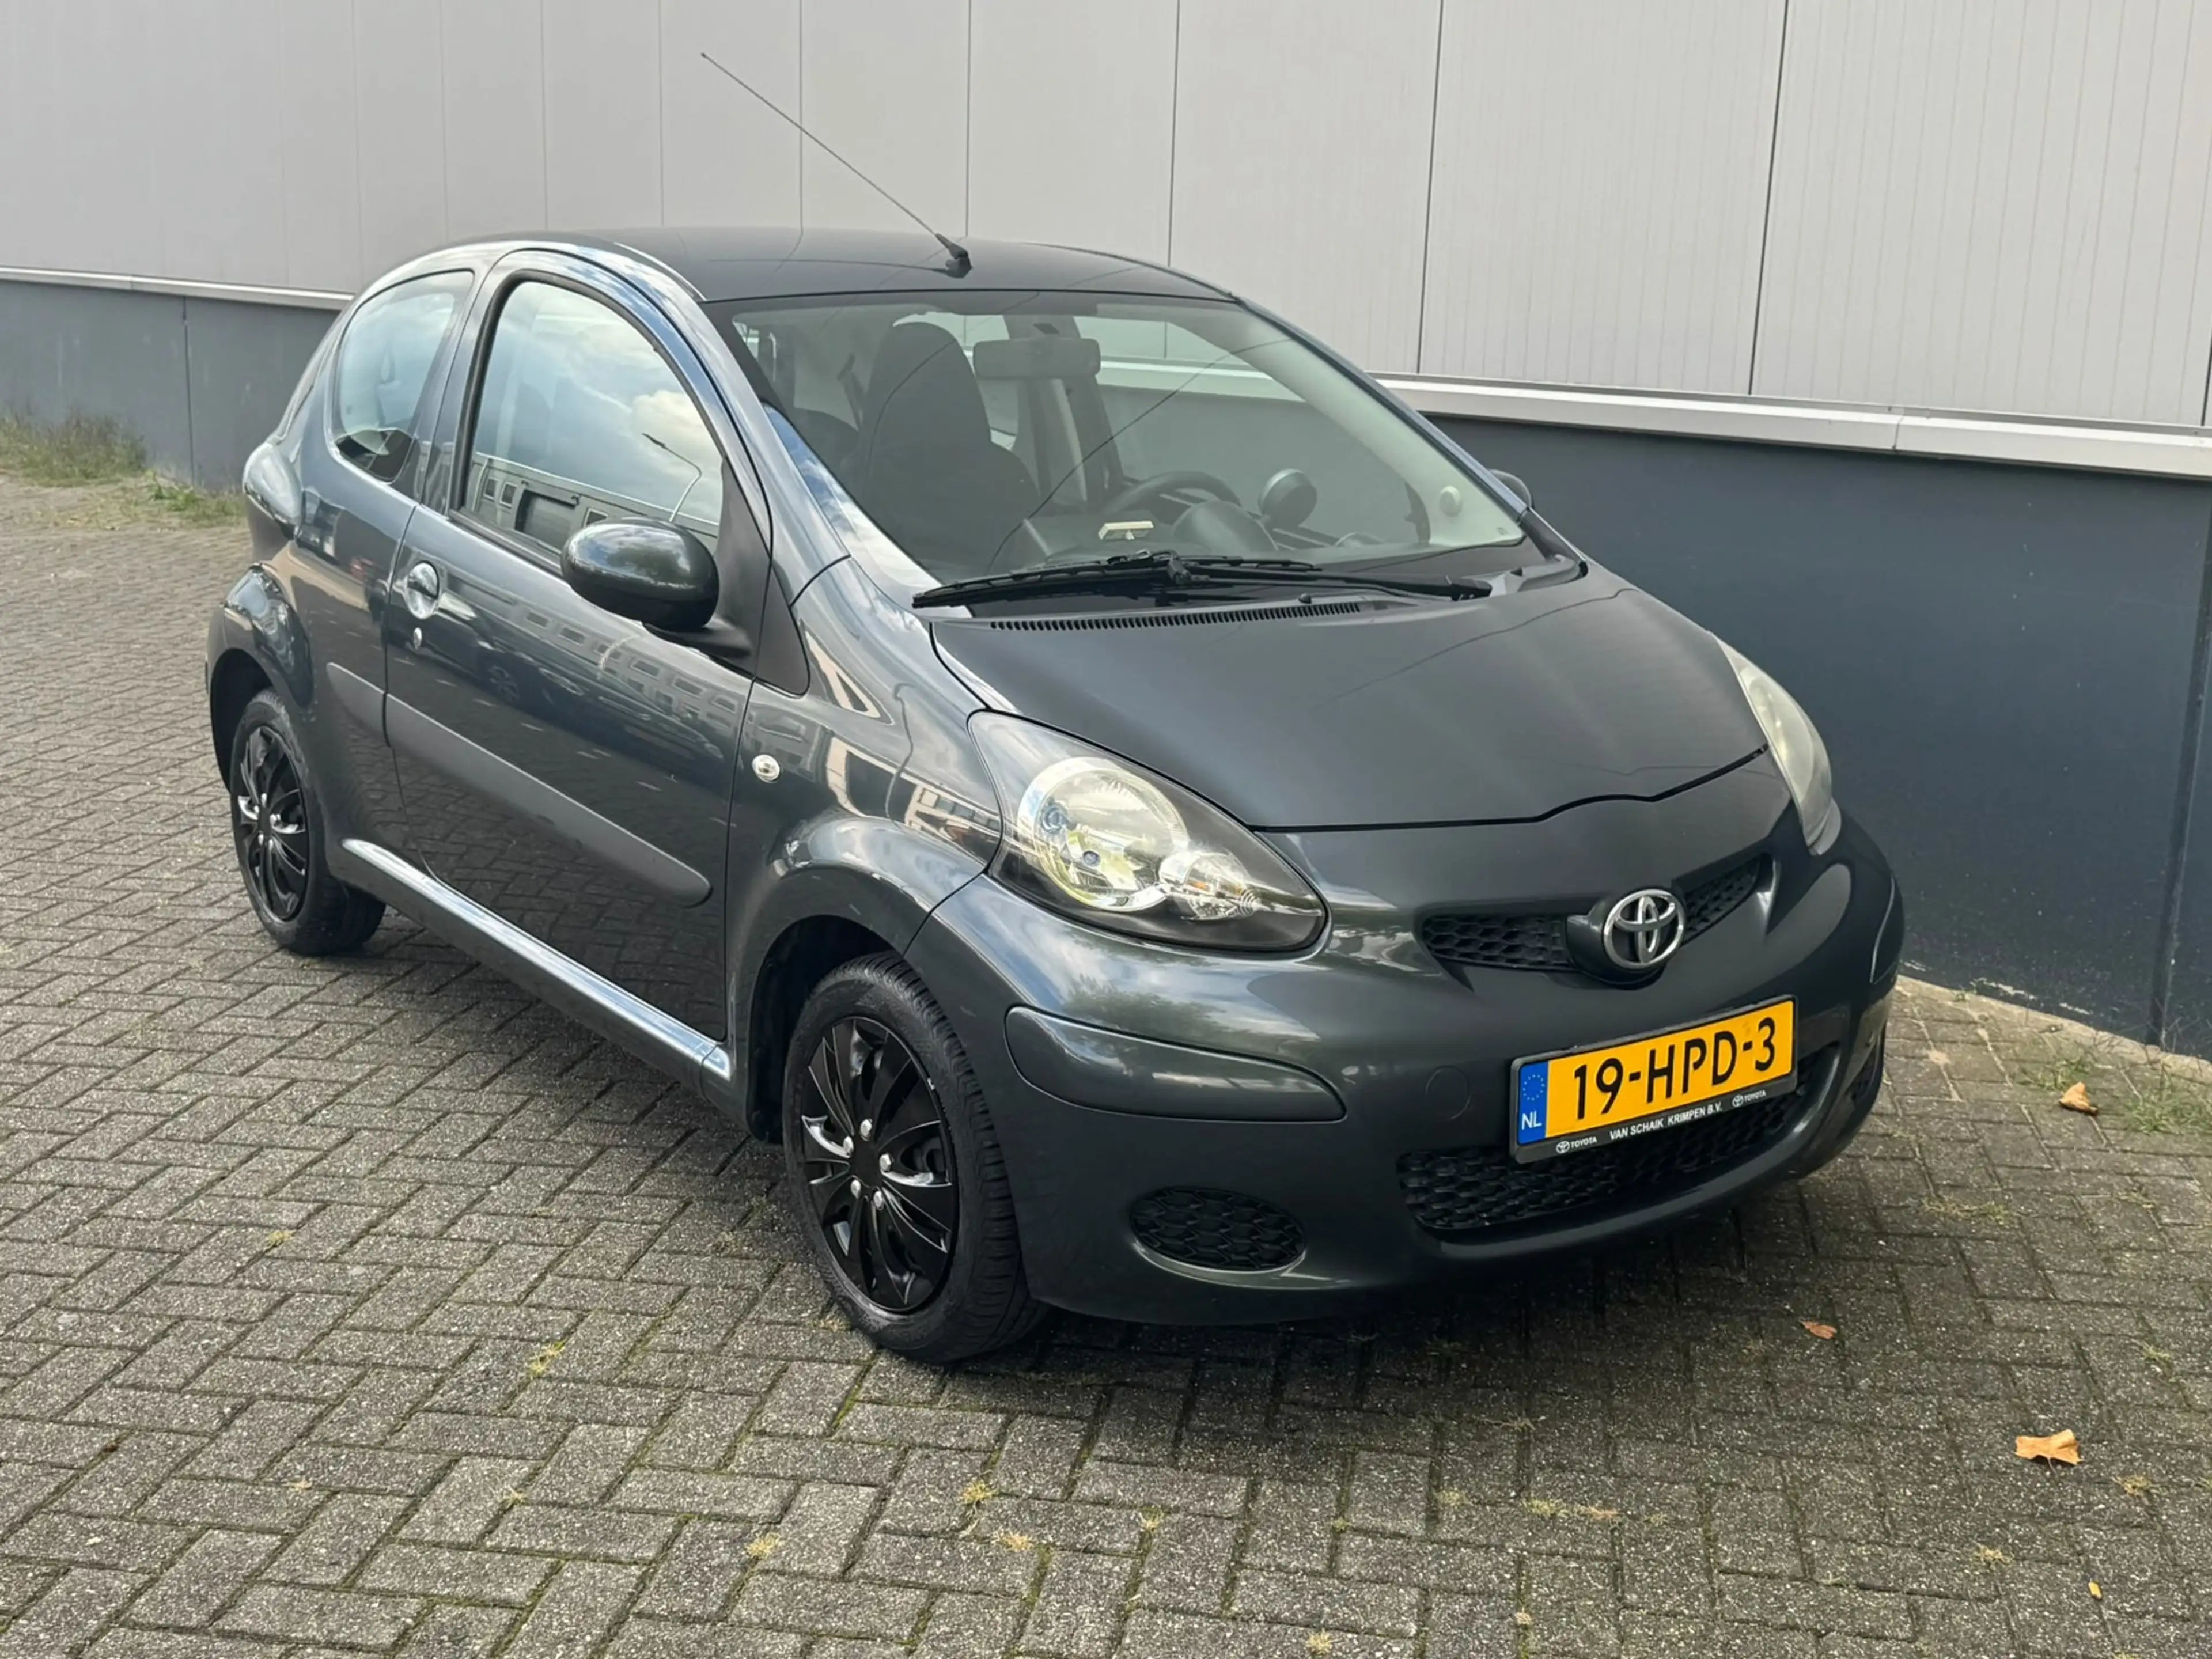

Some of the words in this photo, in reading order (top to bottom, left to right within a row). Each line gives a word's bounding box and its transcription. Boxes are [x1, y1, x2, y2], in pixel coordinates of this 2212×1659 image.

[1574, 1017, 1775, 1120] 19-HPD-3
[1744, 1090, 1766, 1103] TOYOTA
[1521, 1112, 1542, 1130] NL
[1609, 1126, 1629, 1141] VAN
[1630, 1119, 1664, 1135] SCHAIK
[1668, 1107, 1706, 1126] KRIMPEN
[1707, 1101, 1722, 1115] B.V.
[1570, 1136, 1597, 1149] TOYOTA
